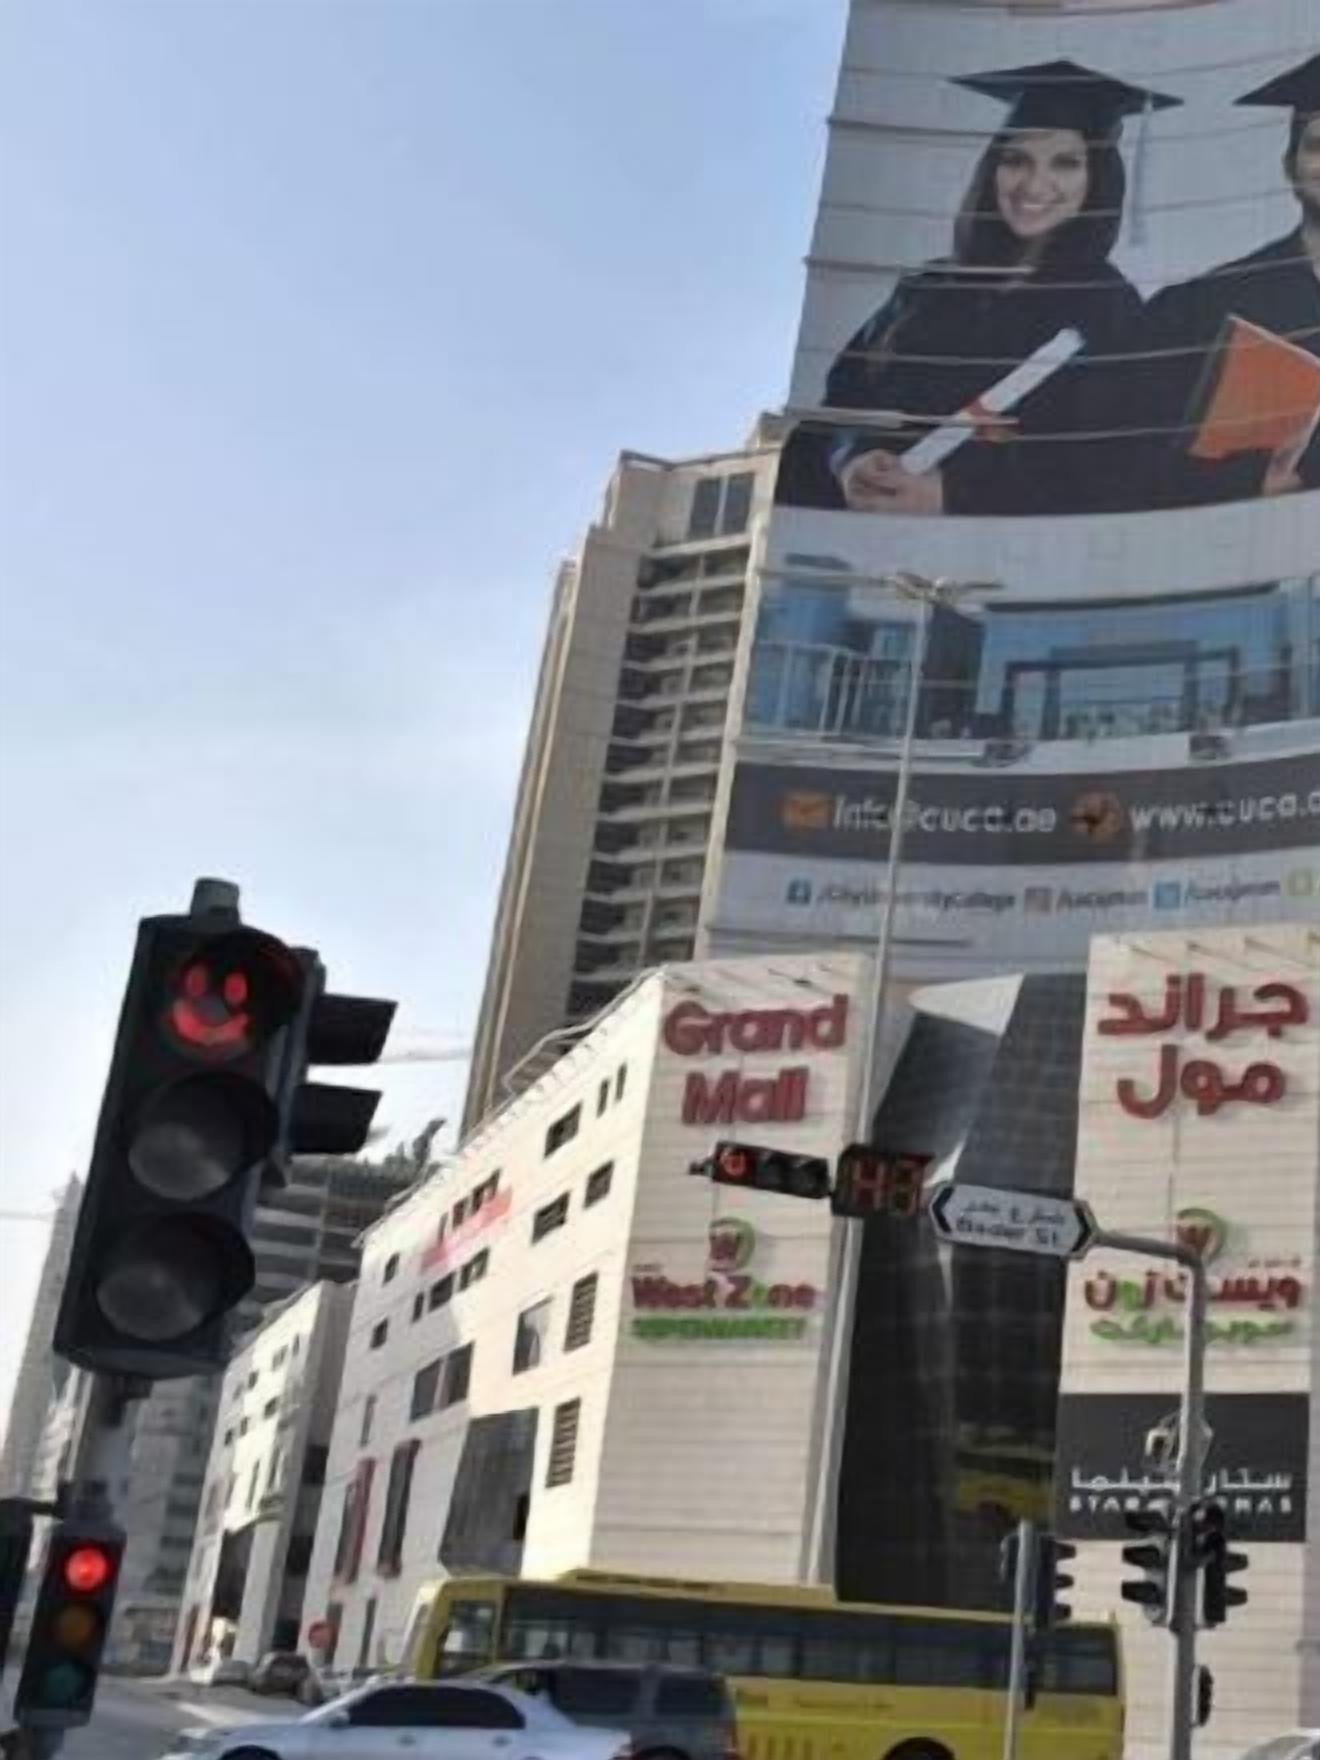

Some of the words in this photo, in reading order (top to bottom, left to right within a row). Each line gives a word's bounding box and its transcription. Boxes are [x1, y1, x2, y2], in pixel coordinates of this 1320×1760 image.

[663, 993, 849, 1056] Grand
[1097, 973, 1309, 1040] جراند
[681, 1066, 809, 1125] Mall
[1117, 1043, 1286, 1119] مول
